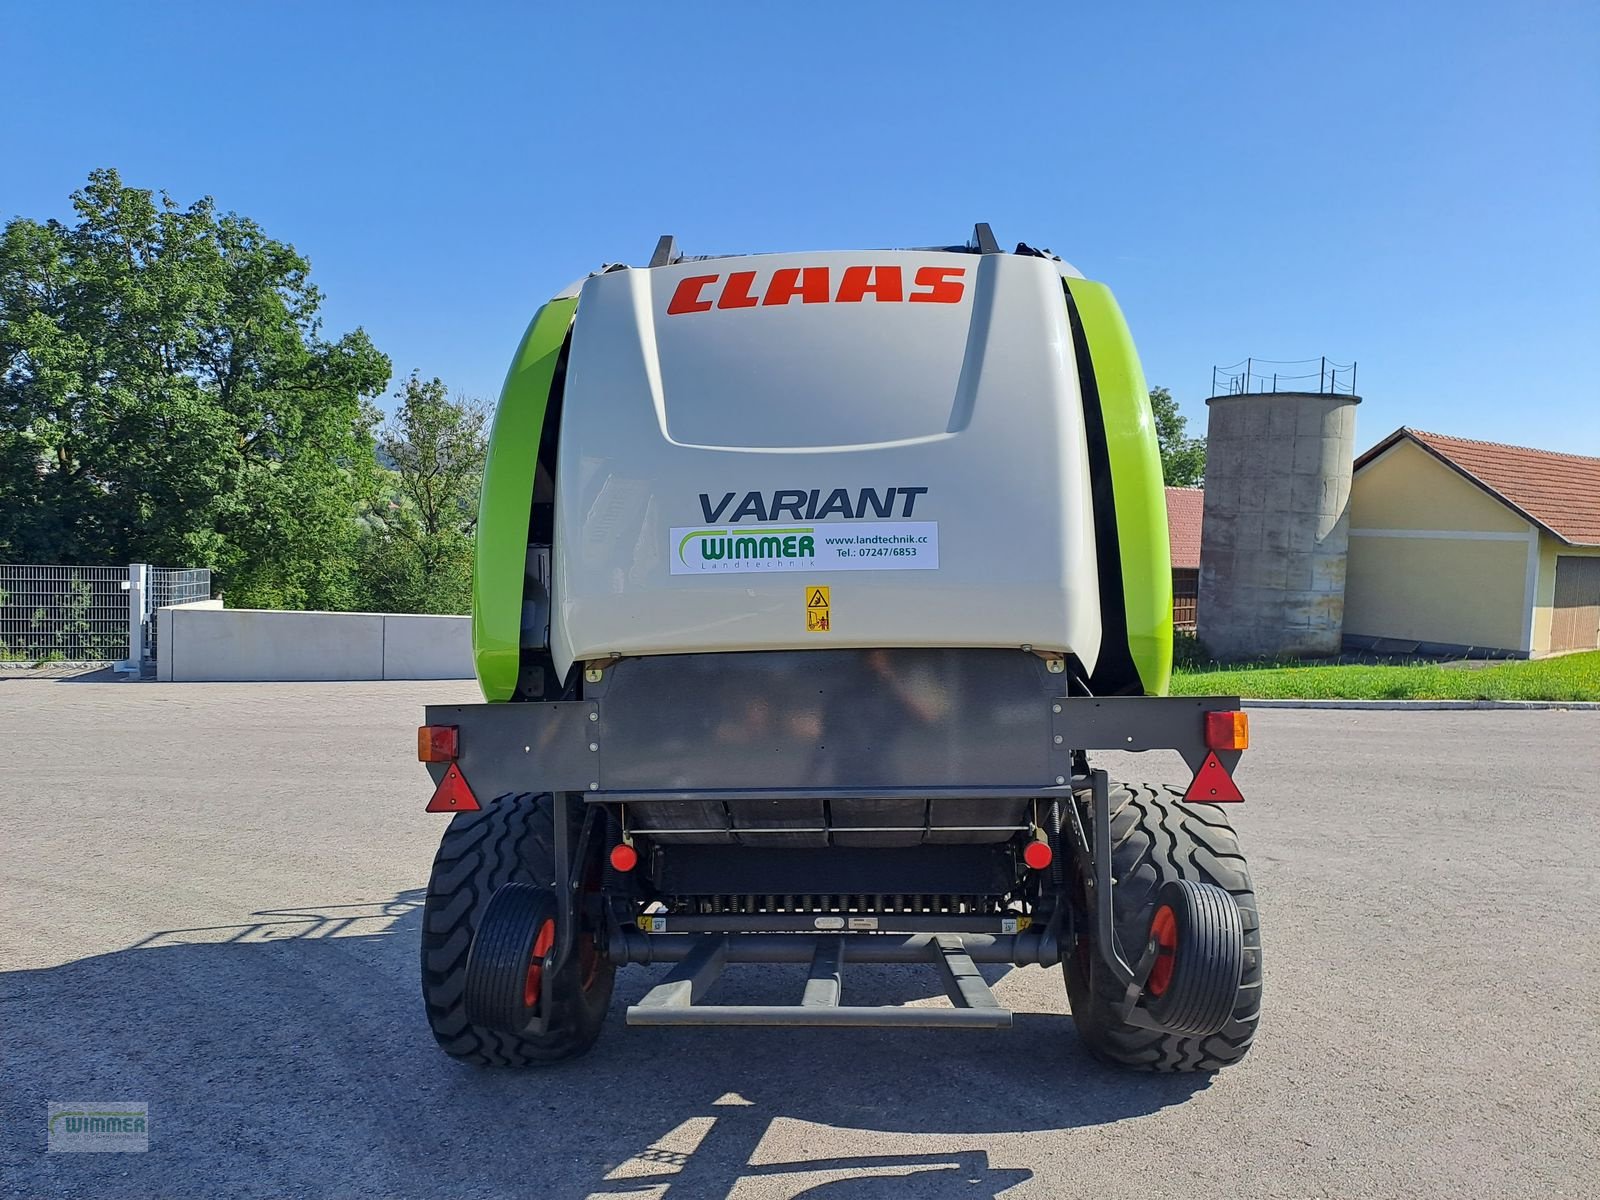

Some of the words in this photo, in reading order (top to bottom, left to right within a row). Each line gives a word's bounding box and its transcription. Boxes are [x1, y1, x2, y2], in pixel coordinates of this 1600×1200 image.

[666, 265, 966, 316] CLAAS
[699, 486, 929, 523] VARIANT
[701, 535, 815, 560] WIMMER
[825, 534, 928, 545] www.landtechnik.cc
[836, 548, 856, 557] Tel.:
[859, 547, 917, 557] 07247/6853
[701, 560, 815, 570] Landtechnik
